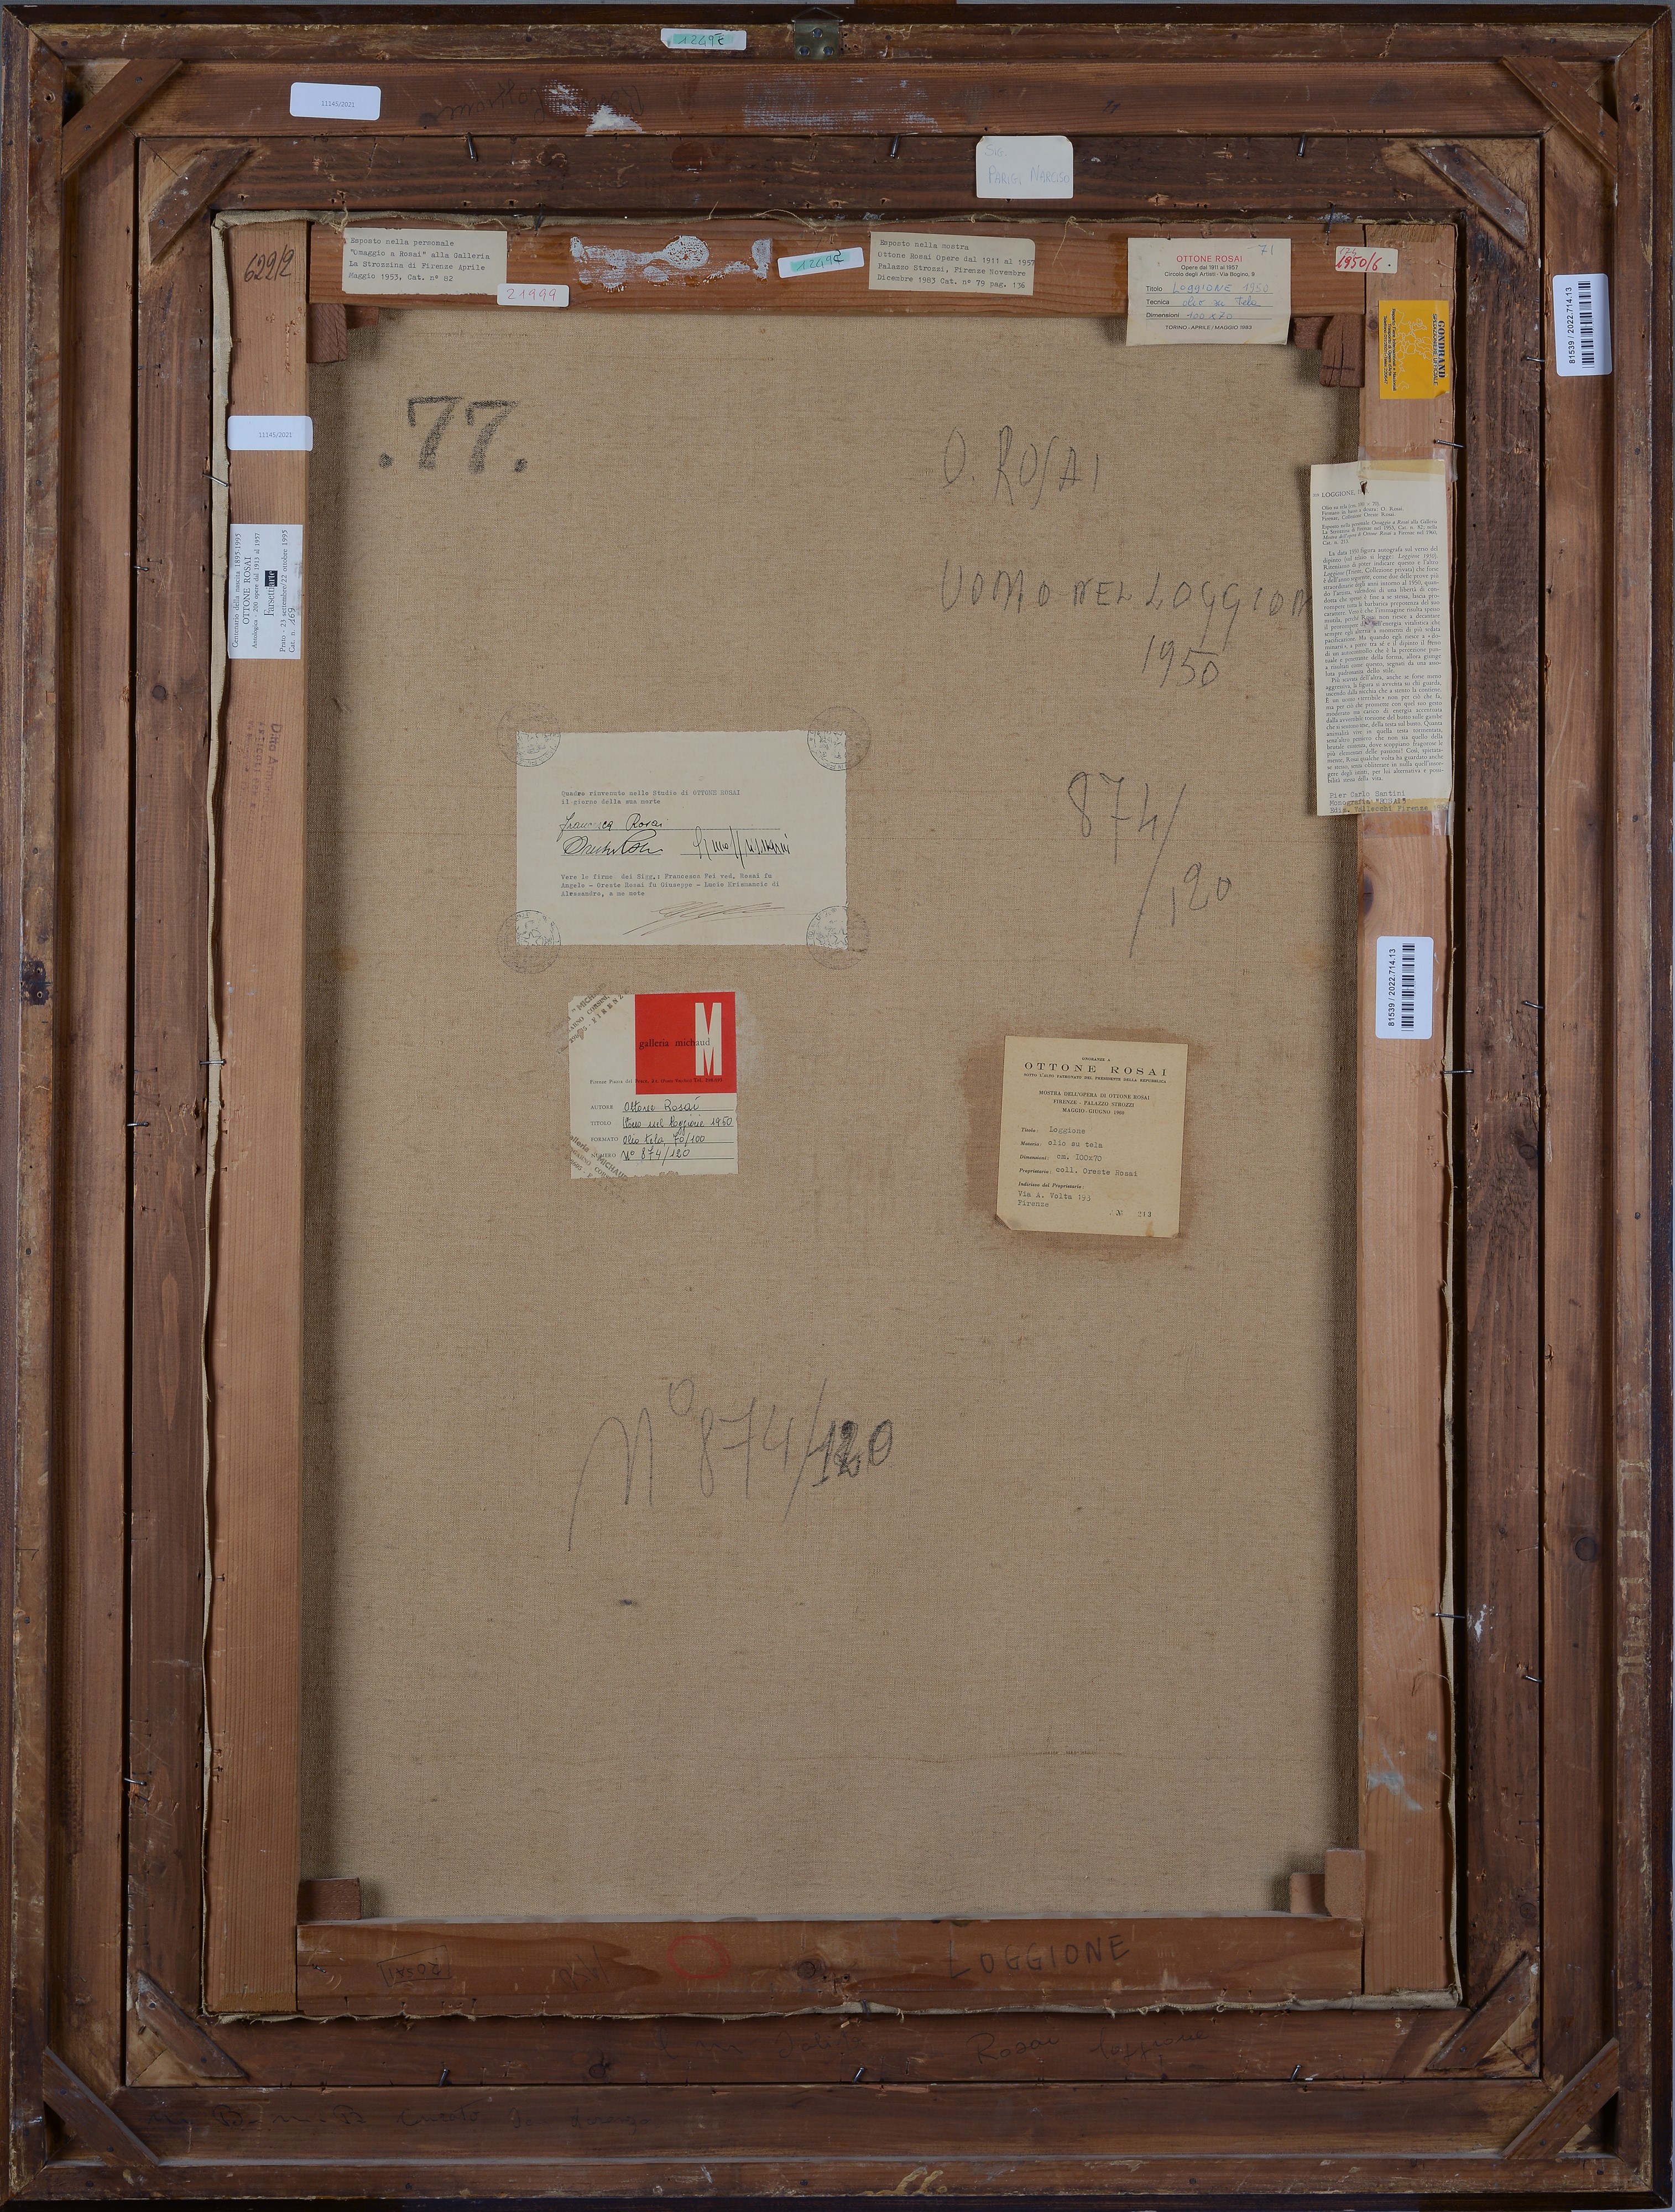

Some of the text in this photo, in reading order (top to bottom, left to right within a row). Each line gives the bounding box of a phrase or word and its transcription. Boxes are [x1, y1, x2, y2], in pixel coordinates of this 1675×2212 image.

[880, 239, 910, 248] Esposto
[936, 254, 959, 263] Opere
[458, 264, 485, 272] Aprile
[914, 264, 948, 273] Strozzi,
[507, 288, 557, 301] 21999
[1243, 284, 1269, 293] 1950
[1566, 287, 1574, 333] 2022.714.13
[264, 571, 275, 617] Farsettiarte
[1142, 635, 1219, 688] 1950
[639, 1038, 710, 1050] galleria michaud
[1025, 1062, 1166, 1076] OTTONE ROSAI
[1049, 1126, 1085, 1134] Loggione
[949, 1933, 1130, 1979] LOGGIONE
